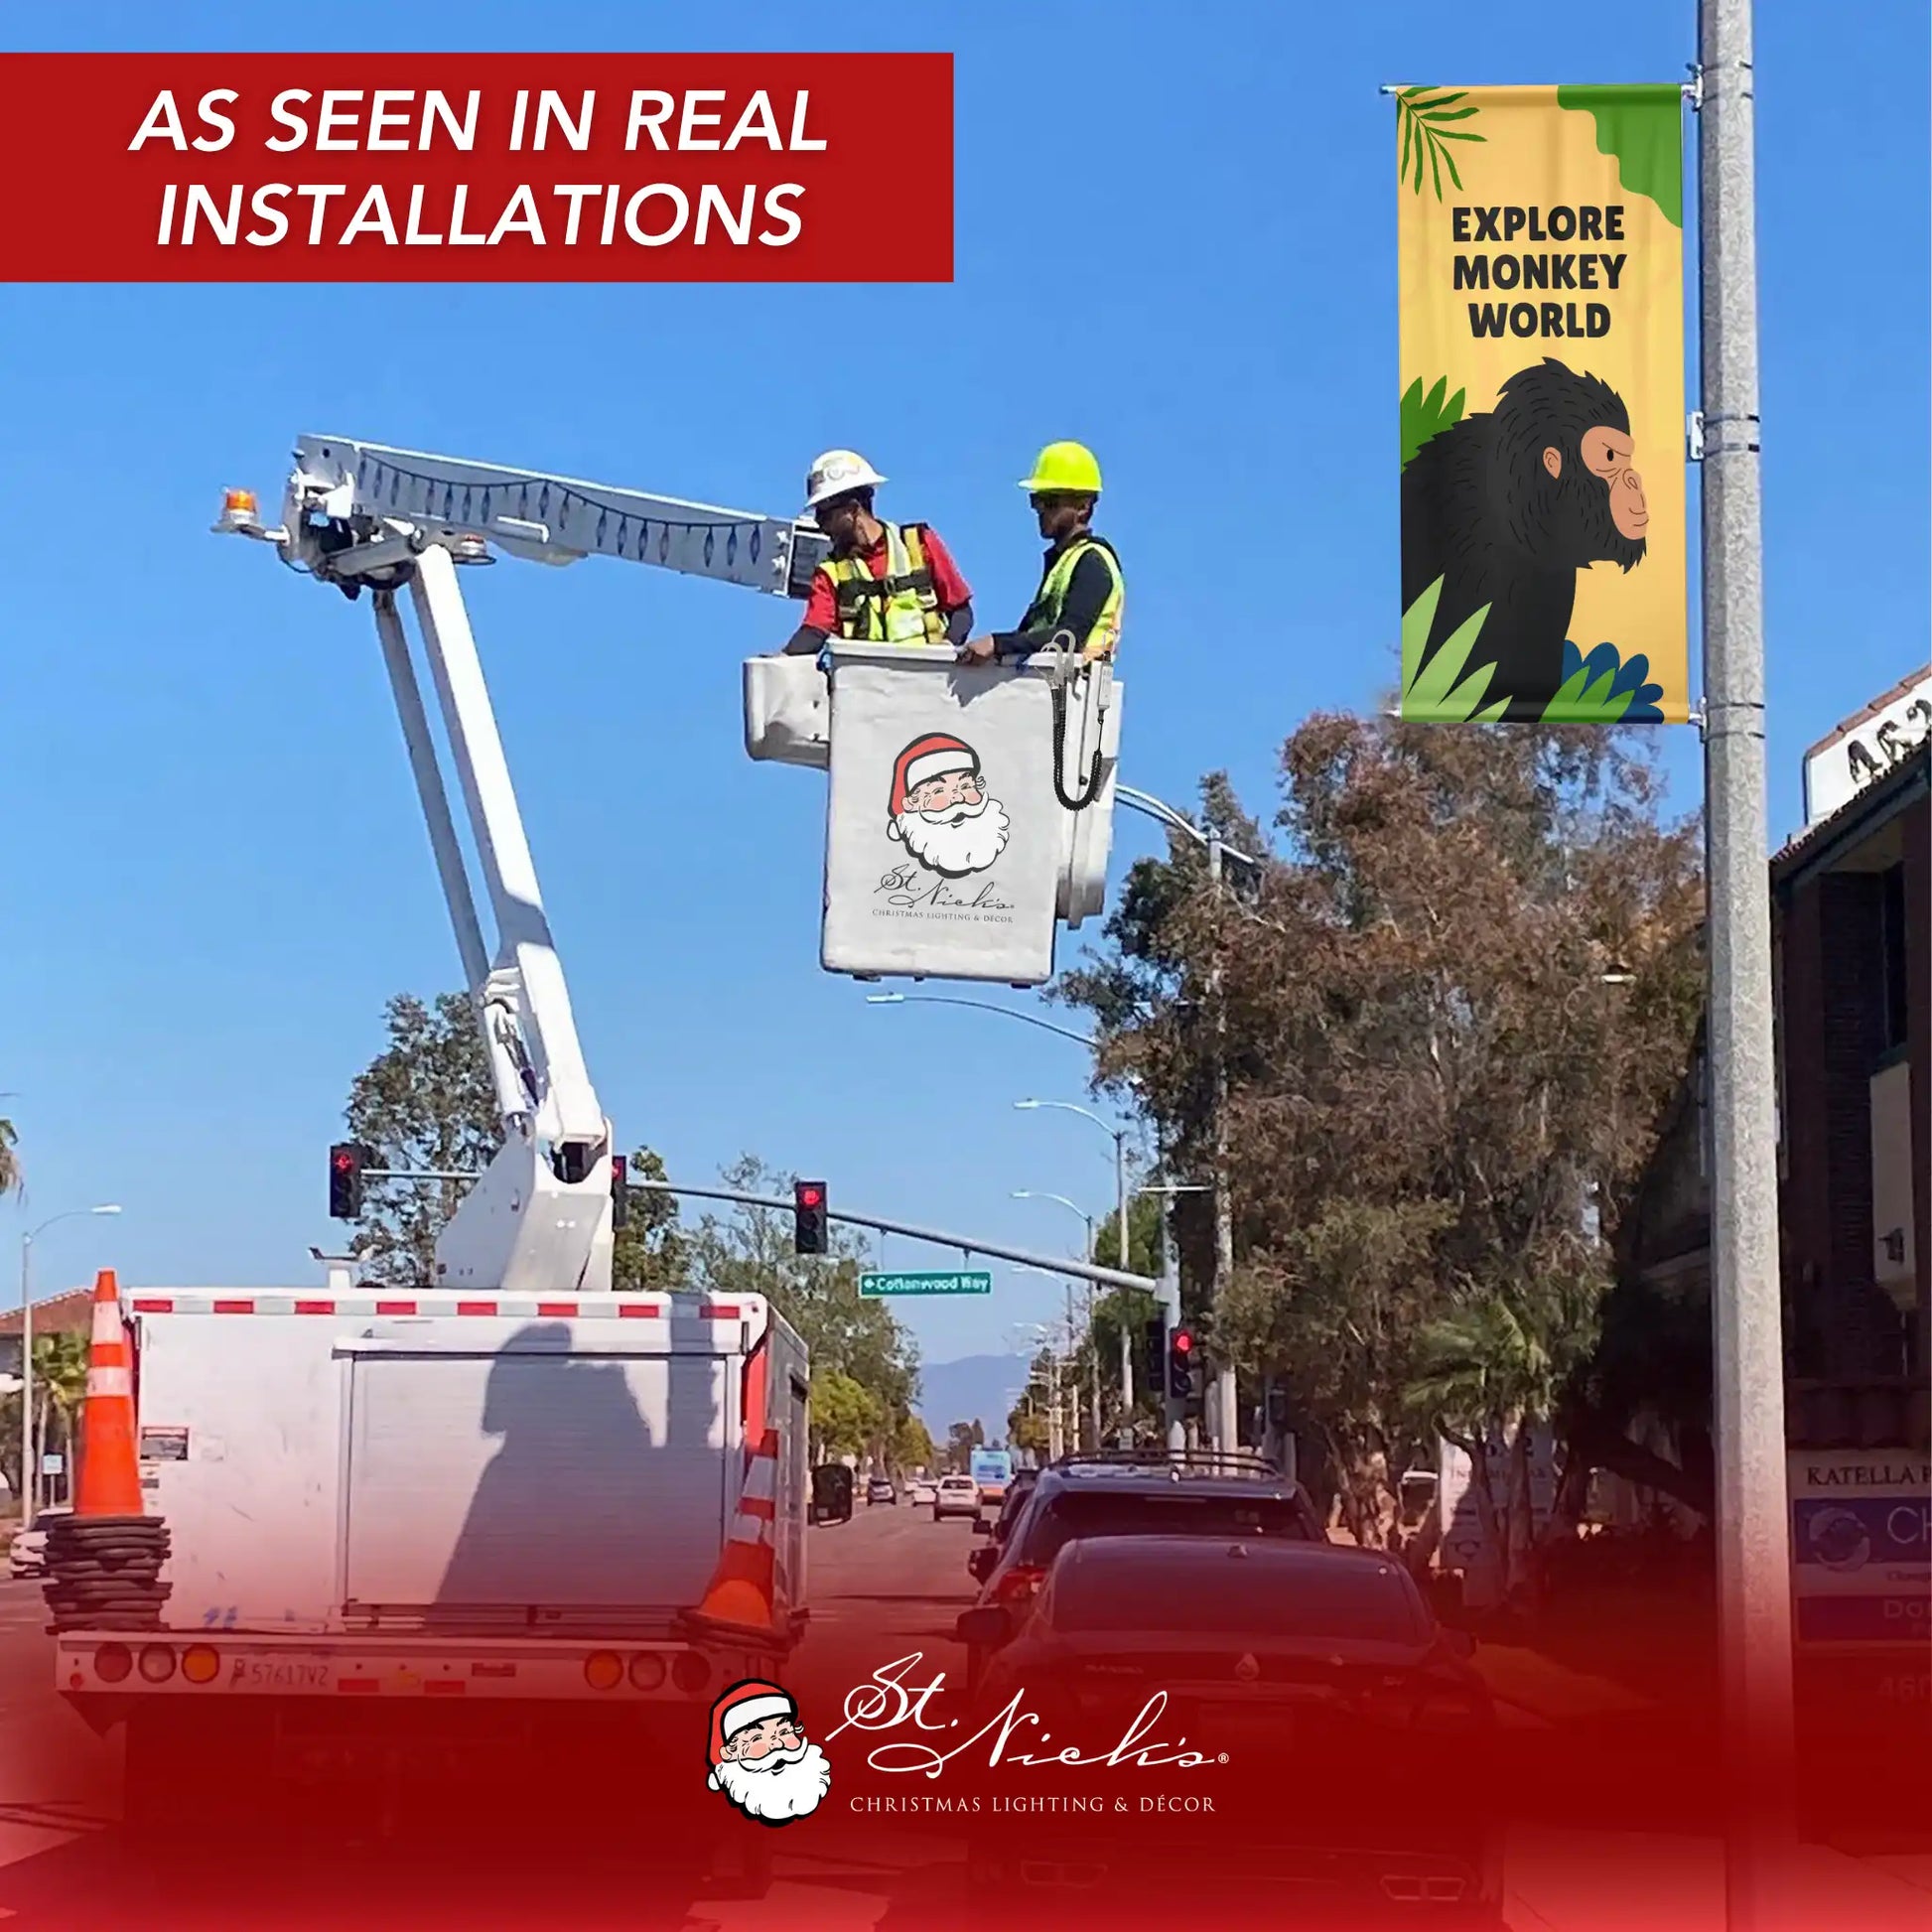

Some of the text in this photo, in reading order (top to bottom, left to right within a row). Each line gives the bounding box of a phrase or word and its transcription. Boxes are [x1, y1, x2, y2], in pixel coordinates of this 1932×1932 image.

[1452, 206, 1625, 241] EXPLORE
[1453, 254, 1627, 290] MONKEY
[1468, 302, 1611, 338] WORLD
[874, 863, 921, 894] St.
[872, 908, 923, 919] CHRISTMAS
[926, 912, 971, 921] LIGHTING
[877, 1276, 989, 1293] Cottonwood Way
[1807, 1465, 1916, 1485] KATELLA
